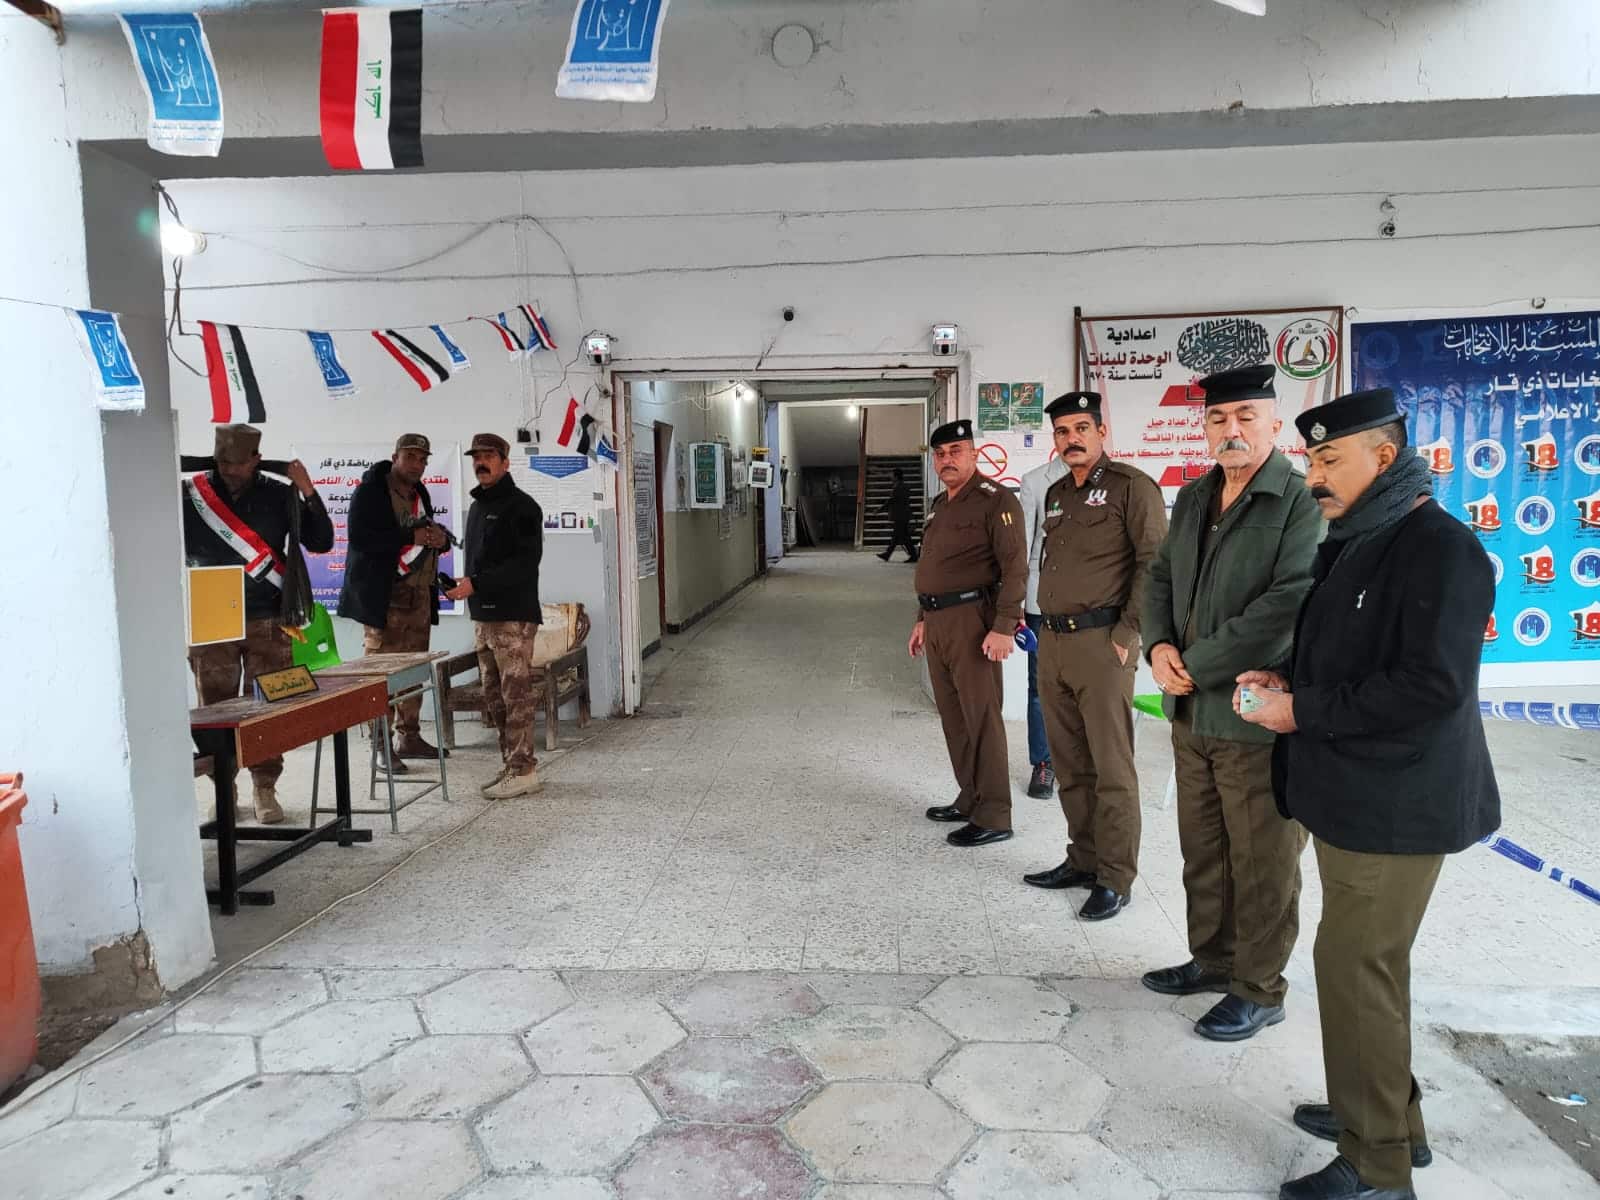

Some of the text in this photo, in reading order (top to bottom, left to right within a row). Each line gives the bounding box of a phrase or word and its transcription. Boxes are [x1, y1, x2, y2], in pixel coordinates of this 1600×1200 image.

[1087, 351, 1172, 369] الوحدة للبنات
[1108, 369, 1126, 380] سنة
[1483, 373, 1520, 396] قار
[1522, 371, 1543, 396] ذي
[1523, 556, 1556, 584] 18
